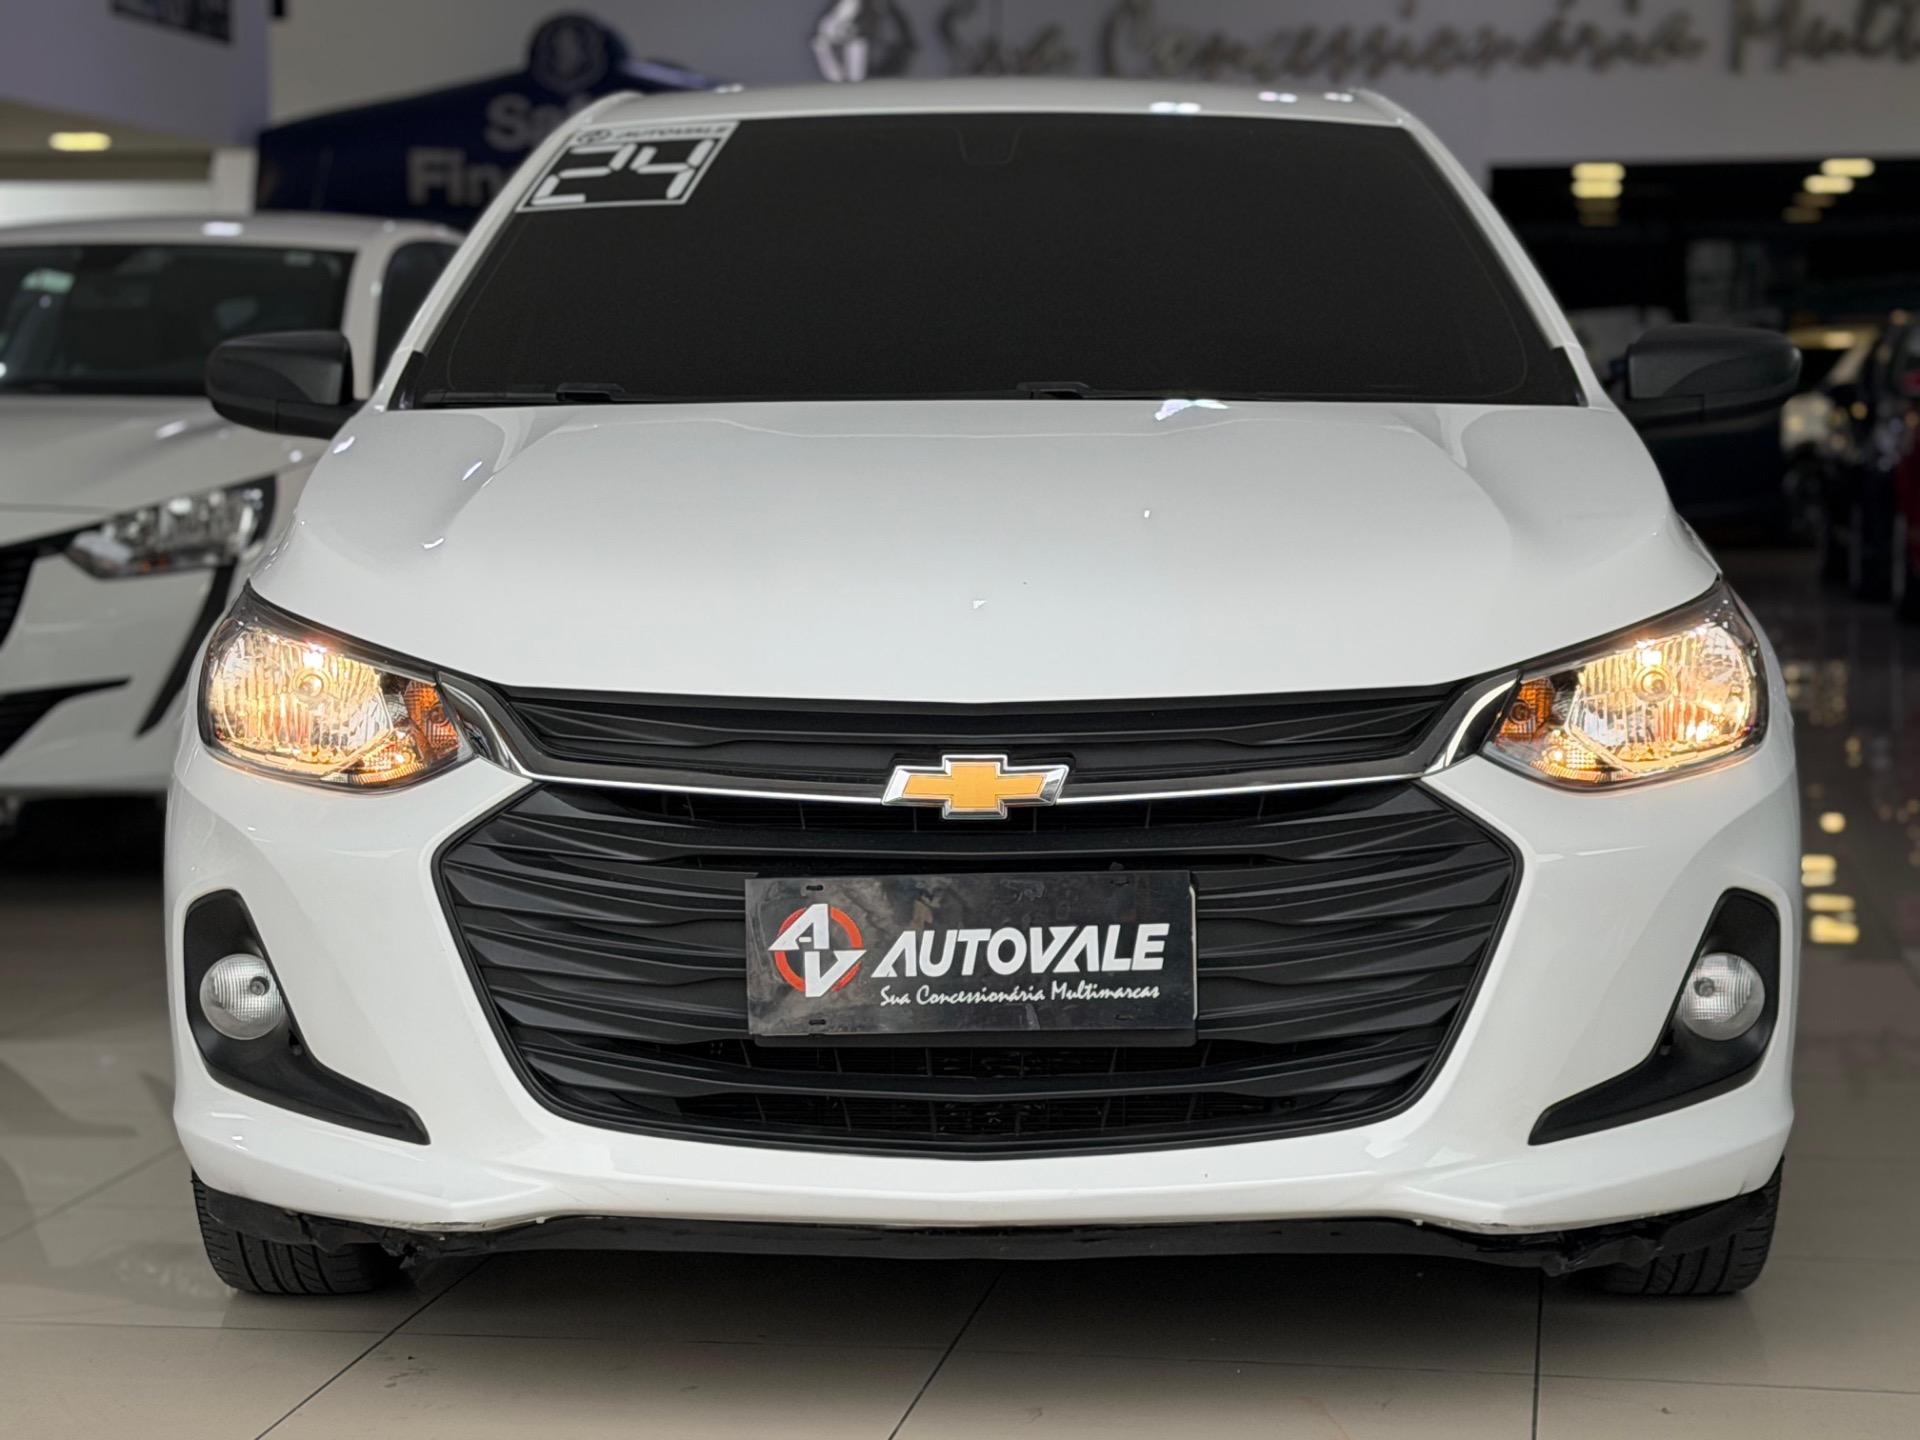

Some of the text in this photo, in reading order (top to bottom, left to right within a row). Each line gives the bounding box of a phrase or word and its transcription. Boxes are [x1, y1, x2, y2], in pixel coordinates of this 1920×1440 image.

[530, 138, 715, 206] 24
[870, 922, 1170, 978] AUTOVALE
[880, 979, 1161, 1006] Sua Concessionária Multimarcas
